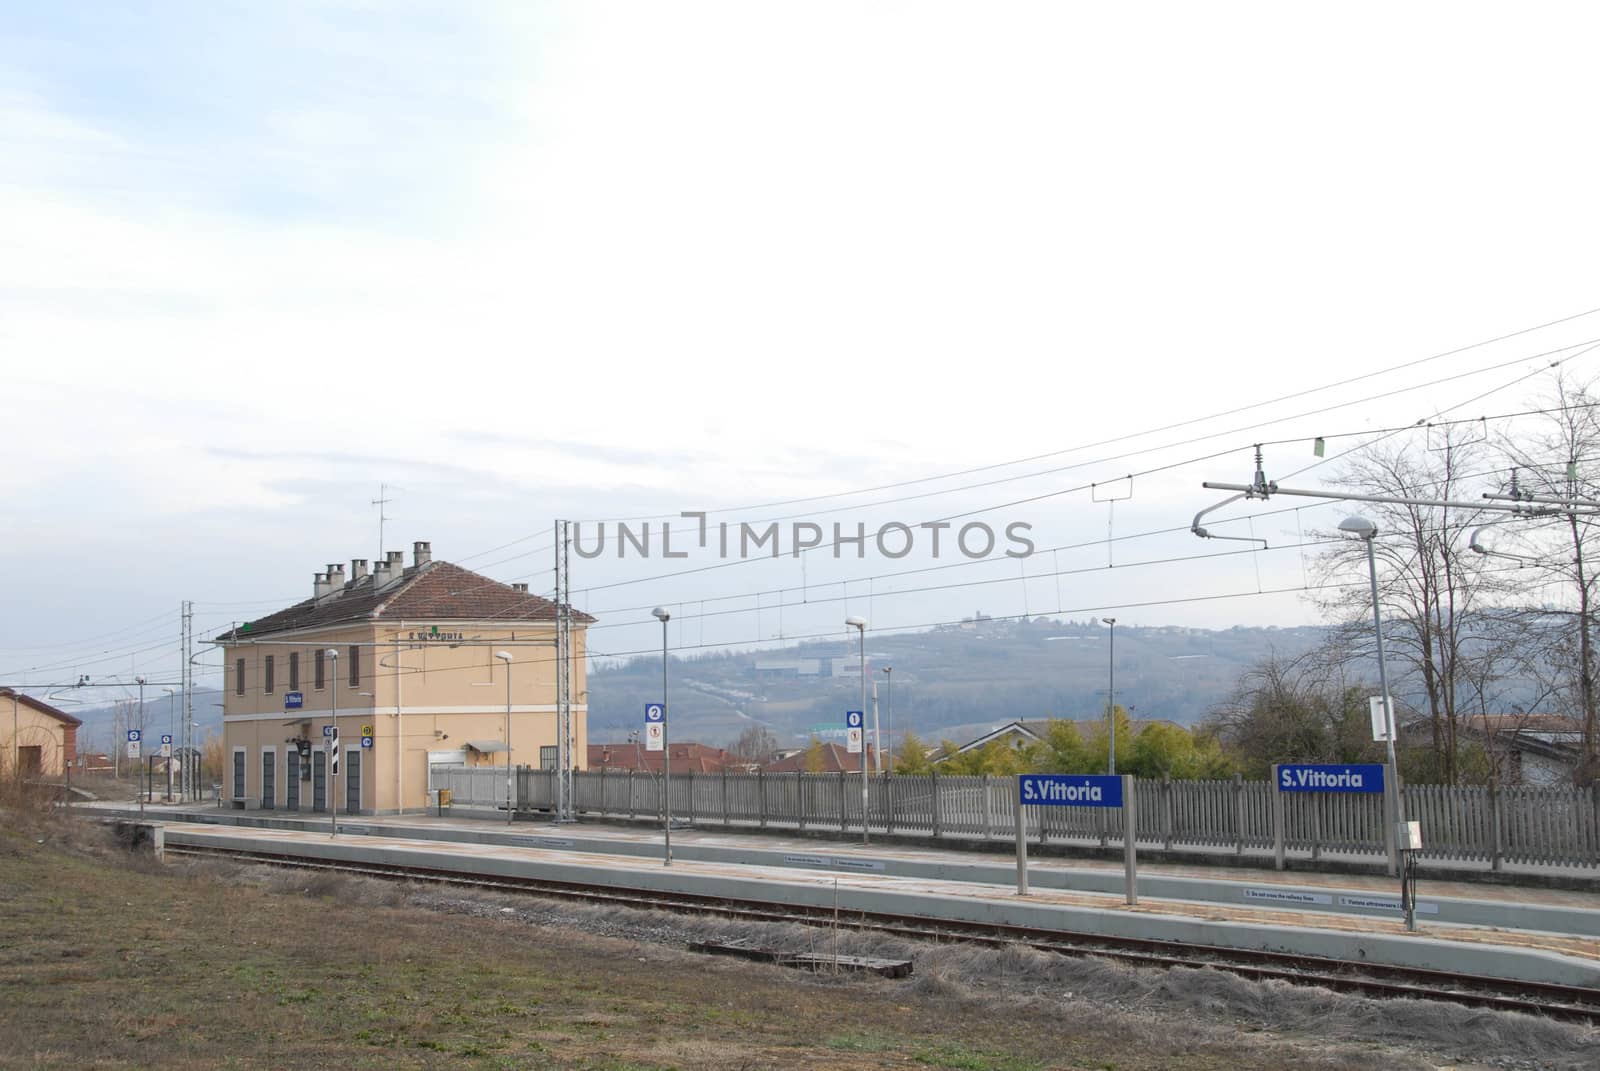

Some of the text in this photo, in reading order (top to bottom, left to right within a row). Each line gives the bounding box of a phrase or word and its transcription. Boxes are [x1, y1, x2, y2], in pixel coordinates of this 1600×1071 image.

[651, 707, 658, 718] 2
[1281, 769, 1363, 787] S.Vittoria
[1024, 779, 1102, 801] S.Vittoria
